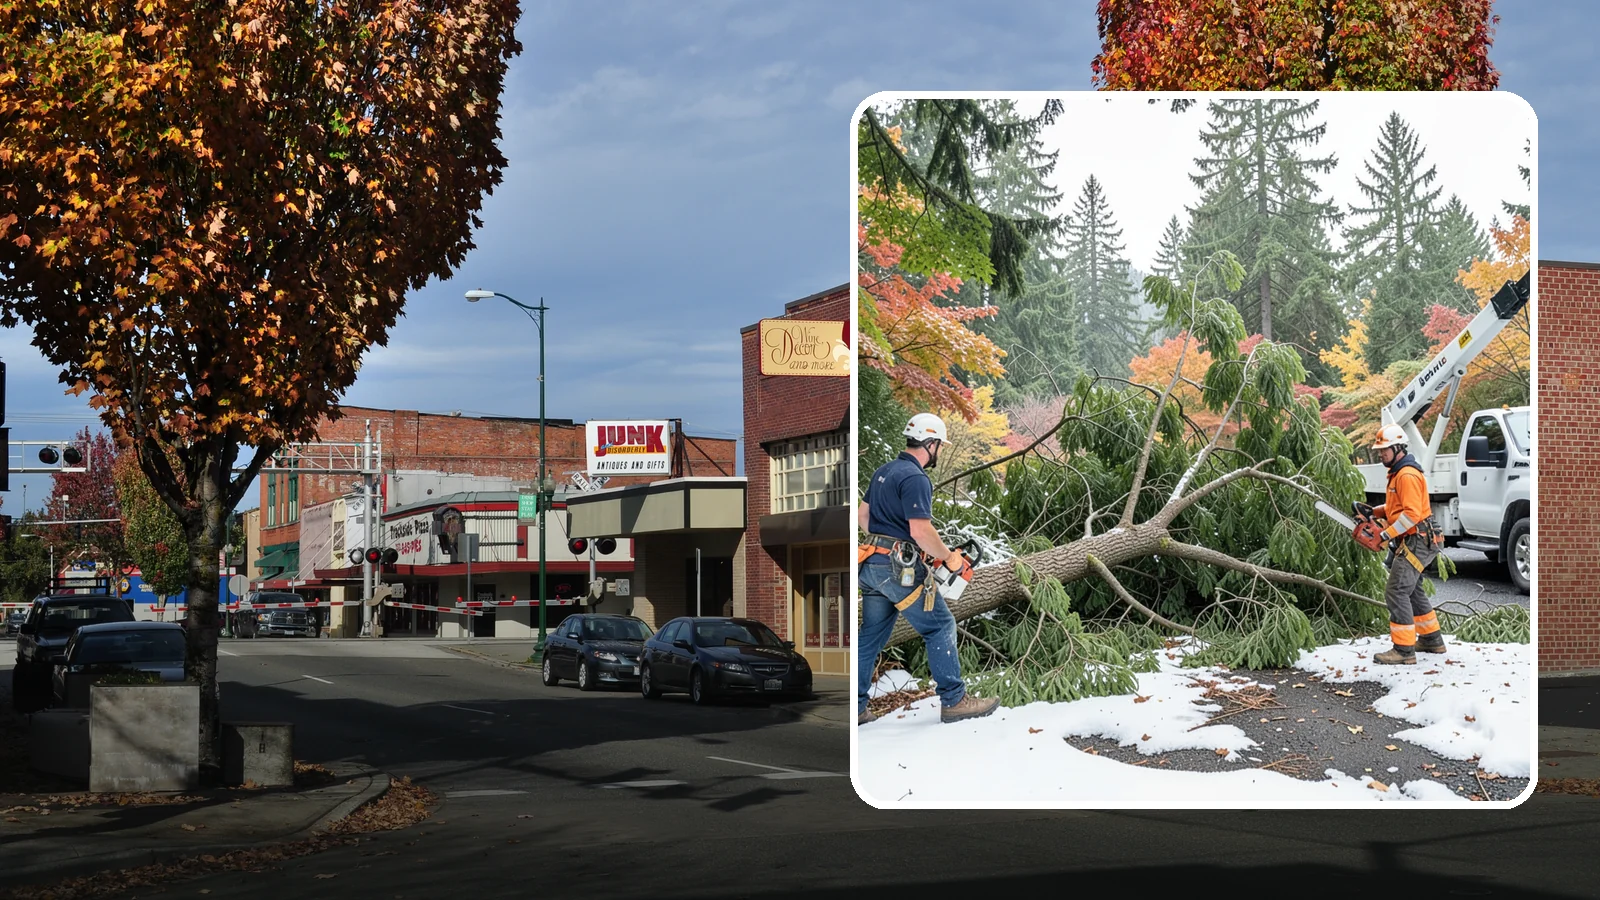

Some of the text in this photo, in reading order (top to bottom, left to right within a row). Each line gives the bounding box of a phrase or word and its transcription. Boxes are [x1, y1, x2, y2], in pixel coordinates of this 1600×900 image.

[595, 425, 665, 457] JUNK
[607, 446, 646, 454] DISORDERLY
[597, 460, 665, 470] ANTIQUES AND GIFTS
